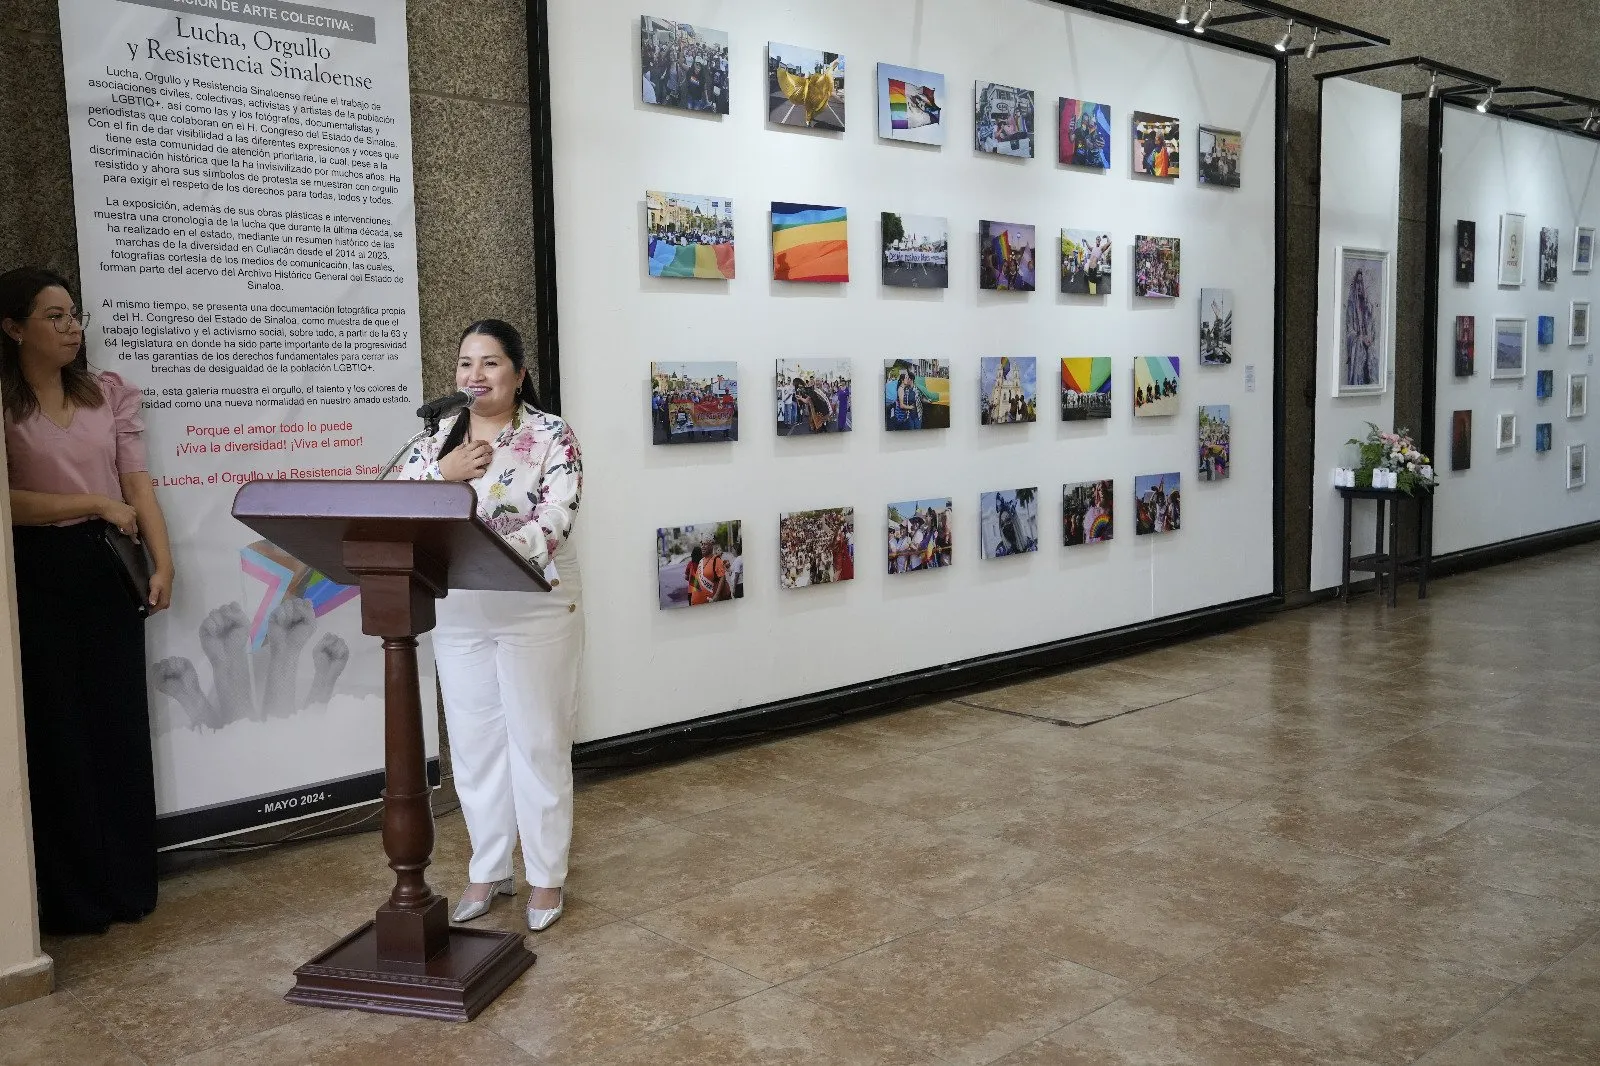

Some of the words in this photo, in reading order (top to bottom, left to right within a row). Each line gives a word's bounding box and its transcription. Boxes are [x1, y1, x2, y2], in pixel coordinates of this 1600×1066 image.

[222, 0, 239, 13] DE
[242, 4, 277, 19] ARTE
[280, 10, 354, 32] COLECTIVA:
[176, 16, 246, 50] Lucha,
[254, 31, 330, 59] Orgullo
[127, 42, 138, 61] y
[146, 38, 263, 75] Resistencia
[270, 58, 372, 89] Sinaloense
[106, 66, 141, 81] Lucha,
[144, 72, 181, 84] Orgullo
[183, 78, 189, 87] y
[192, 78, 247, 93] Resistencia
[88, 80, 156, 94] asociaciones
[248, 100, 290, 111] activistas
[292, 105, 297, 114] y
[300, 105, 331, 116] artistas
[184, 104, 211, 114] como
[214, 106, 228, 116] las
[231, 110, 236, 119] y
[239, 109, 252, 119] los
[88, 107, 145, 119] periodistas
[148, 113, 167, 122] que
[170, 115, 218, 128] colaboran
[260, 124, 303, 137] Congreso
[87, 118, 109, 128] Con
[113, 121, 122, 130] el
[126, 121, 138, 131] fin
[141, 123, 154, 133] de
[157, 124, 173, 134] dar
[176, 127, 223, 140] visibilidad
[251, 136, 295, 148] diferentes
[106, 133, 131, 144] tiene
[135, 137, 156, 146] esta
[159, 140, 213, 152] comunidad
[216, 144, 228, 154] de
[231, 146, 270, 158] atención
[89, 144, 163, 160] discriminación
[167, 152, 207, 164] histórica
[210, 158, 228, 167] que
[231, 158, 239, 167] la
[242, 159, 253, 168] ha
[256, 160, 312, 174] invisivilizado
[314, 168, 328, 176] por
[389, 173, 400, 182] Ha
[94, 160, 138, 171] resistido
[142, 164, 147, 173] y
[151, 164, 179, 174] ahora
[182, 168, 199, 176] sus
[261, 175, 297, 185] protesta
[103, 175, 126, 184] para
[130, 176, 157, 187] exigir
[160, 178, 169, 187] el
[172, 180, 209, 190] respeto
[211, 182, 223, 191] de
[226, 183, 239, 193] los
[287, 190, 306, 198] para
[106, 198, 118, 207] La
[182, 203, 221, 214] además
[223, 205, 235, 214] de
[238, 208, 254, 216] sus
[285, 210, 322, 220] plásticas
[94, 211, 136, 220] muestra
[139, 214, 158, 222] una
[216, 217, 227, 226] de
[230, 218, 238, 227] la
[268, 223, 285, 231] que
[107, 224, 120, 233] ha
[123, 226, 170, 235] realizado
[188, 228, 196, 237] el
[200, 229, 234, 240] estado,
[237, 232, 279, 242] mediante
[115, 239, 159, 248] marchas
[162, 240, 175, 249] de
[178, 240, 187, 249] la
[190, 241, 238, 252] diversidad
[325, 248, 332, 257] el
[335, 248, 355, 258] 2014
[241, 256, 274, 265] medios
[100, 263, 135, 272] forman
[139, 265, 164, 274] parte
[167, 265, 182, 274] del
[185, 268, 218, 276] acervo
[237, 268, 271, 278] Archivo
[102, 300, 112, 308] Al
[116, 300, 150, 309] mismo
[206, 302, 247, 312] presenta
[112, 313, 128, 322] del
[146, 314, 194, 324] Congreso
[214, 314, 247, 324] Estado
[249, 315, 261, 324] de
[374, 319, 389, 327] que
[102, 326, 138, 336] trabajo
[141, 326, 190, 336] legislativo
[193, 328, 198, 337] y
[201, 326, 210, 335] el
[213, 327, 256, 336] activismo
[289, 328, 313, 337] sobre
[104, 338, 116, 347] 64
[121, 339, 172, 349] legislatura
[191, 339, 220, 348] donde
[238, 339, 256, 348] sido
[259, 340, 282, 350] parte
[118, 352, 131, 360] de
[216, 352, 229, 360] los
[232, 352, 273, 360] derechos
[276, 352, 338, 360] fundamentales
[151, 364, 190, 373] brechas
[193, 364, 205, 373] de
[208, 364, 264, 374] desigualdad
[162, 387, 182, 395] esta
[221, 386, 258, 395] muestra
[255, 397, 304, 406] normalidad
[186, 425, 229, 437] Porque
[233, 424, 243, 435] el
[247, 426, 276, 434] amor
[280, 423, 303, 433] todo
[307, 422, 316, 432] lo
[320, 421, 352, 434] puede
[176, 444, 206, 456] ¡Viva
[210, 443, 220, 453] la
[224, 440, 286, 452] diversidad!
[291, 439, 317, 451] ¡Viva
[321, 438, 330, 448] el
[333, 436, 362, 447] amor!
[164, 475, 204, 486] Lucha,
[208, 473, 218, 484] el
[222, 471, 263, 484] Orgullo
[278, 470, 286, 480] la
[290, 468, 352, 478] Resistencia
[264, 798, 297, 813] MAYO
[300, 792, 324, 805] 2024
